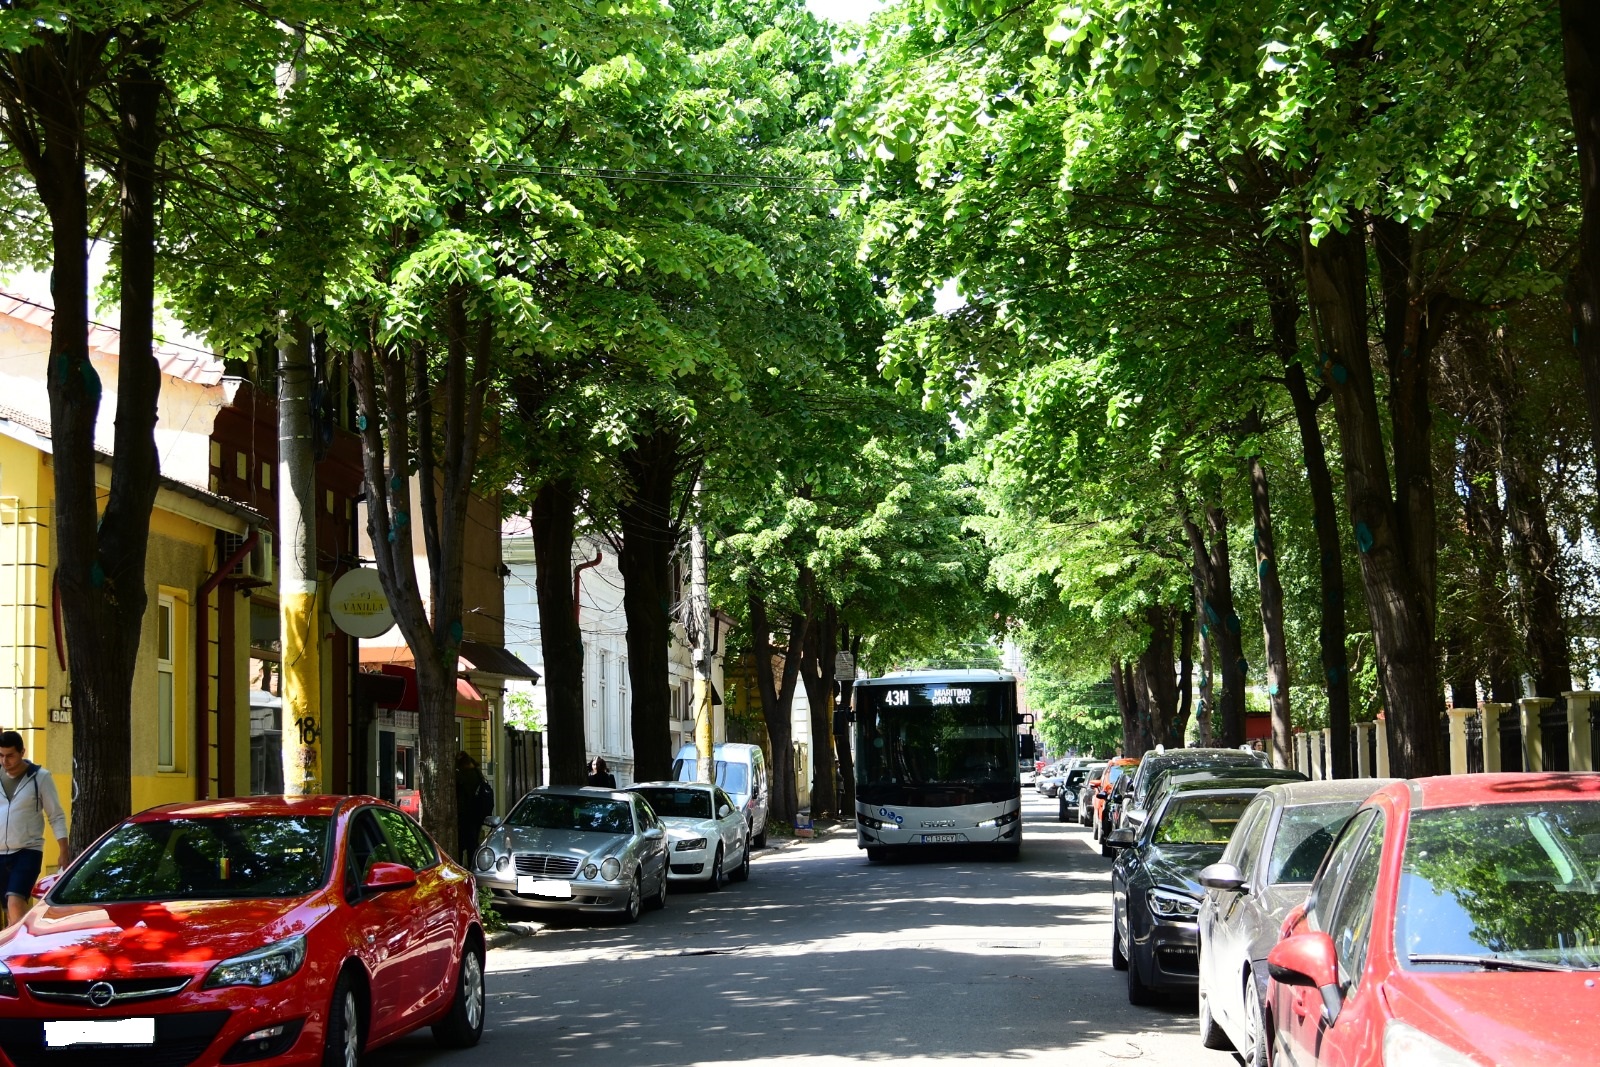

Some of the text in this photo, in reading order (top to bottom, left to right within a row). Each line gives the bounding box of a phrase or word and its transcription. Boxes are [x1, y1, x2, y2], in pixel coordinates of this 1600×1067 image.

[343, 603, 384, 611] VANILLA
[933, 688, 972, 697] MARITIMO
[885, 690, 909, 706] 43M
[931, 696, 971, 705] GARA CFR
[920, 820, 956, 828] ISUZU
